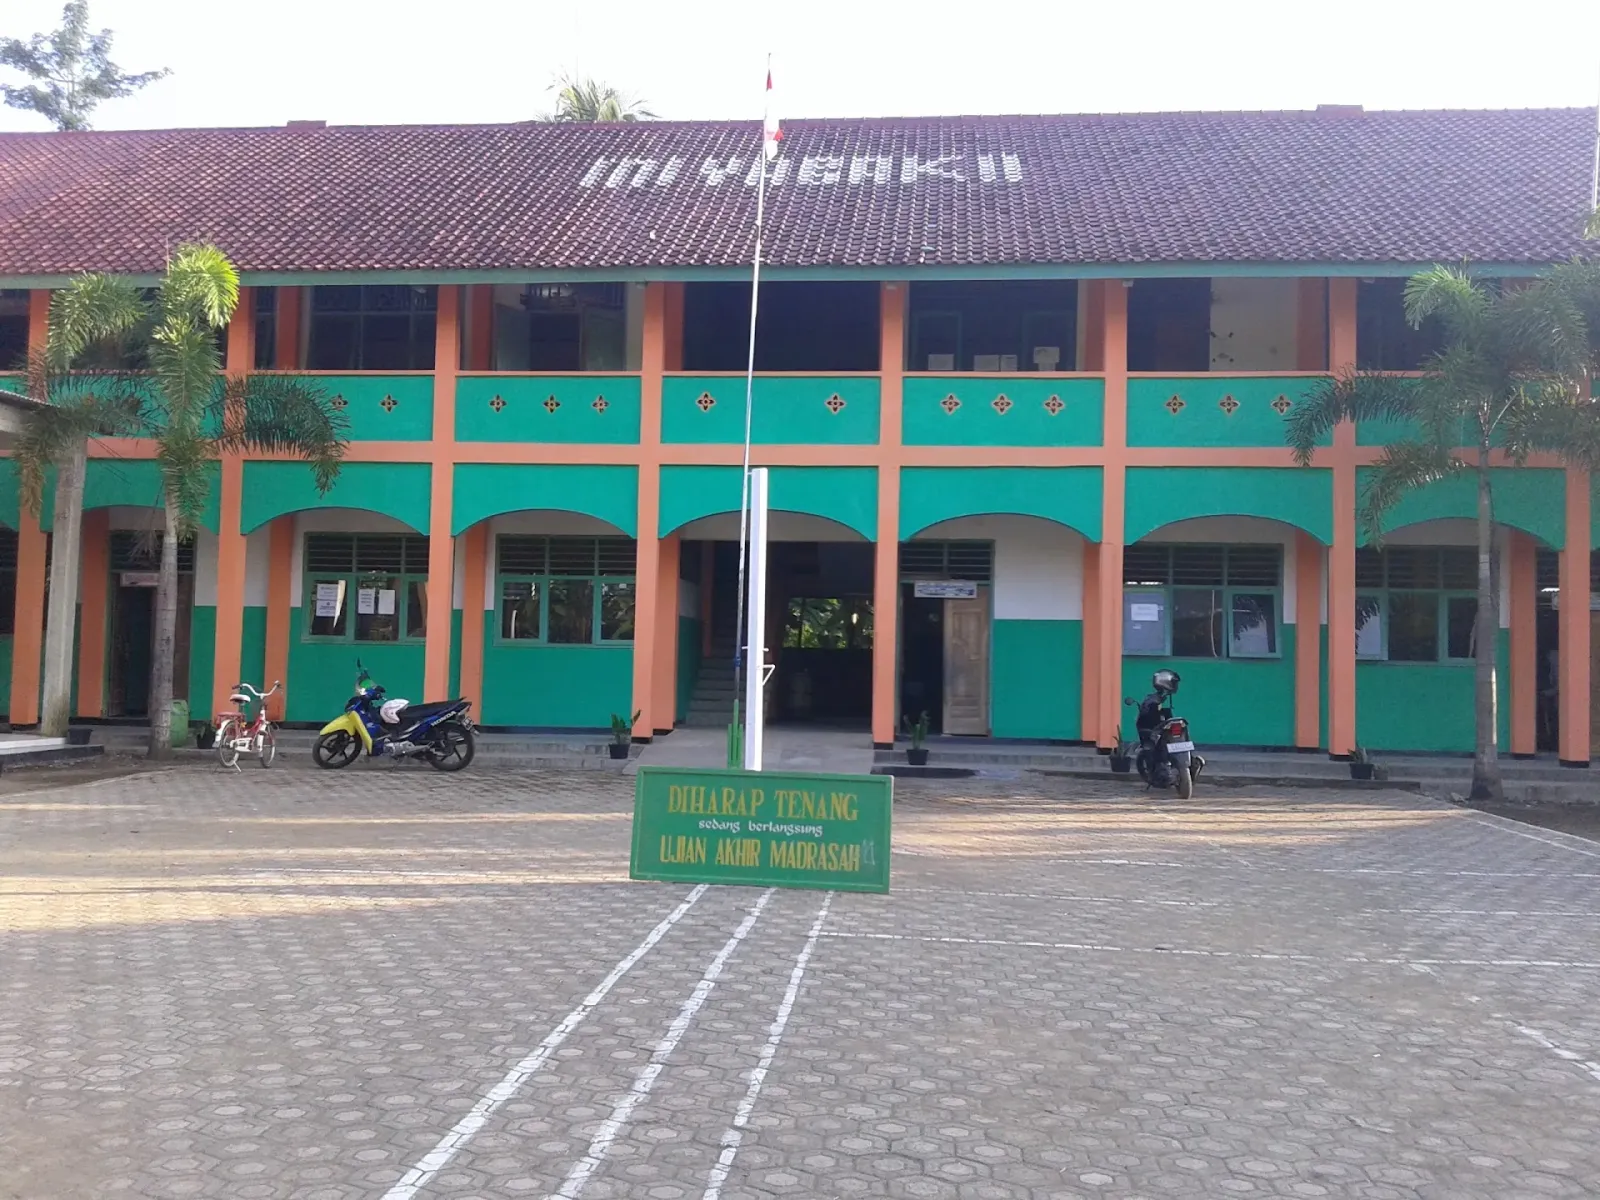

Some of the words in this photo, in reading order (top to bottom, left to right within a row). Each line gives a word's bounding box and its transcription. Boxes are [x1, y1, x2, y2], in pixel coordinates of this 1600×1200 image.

[430, 710, 457, 727] HONDA
[668, 785, 765, 817] DIHARAP
[774, 790, 859, 821] TENANG
[698, 819, 741, 834] sedang
[748, 822, 823, 836] berlangsung
[659, 835, 707, 865] UJIAN
[715, 837, 761, 867] AKHIR
[770, 840, 860, 872] MADRASAH
